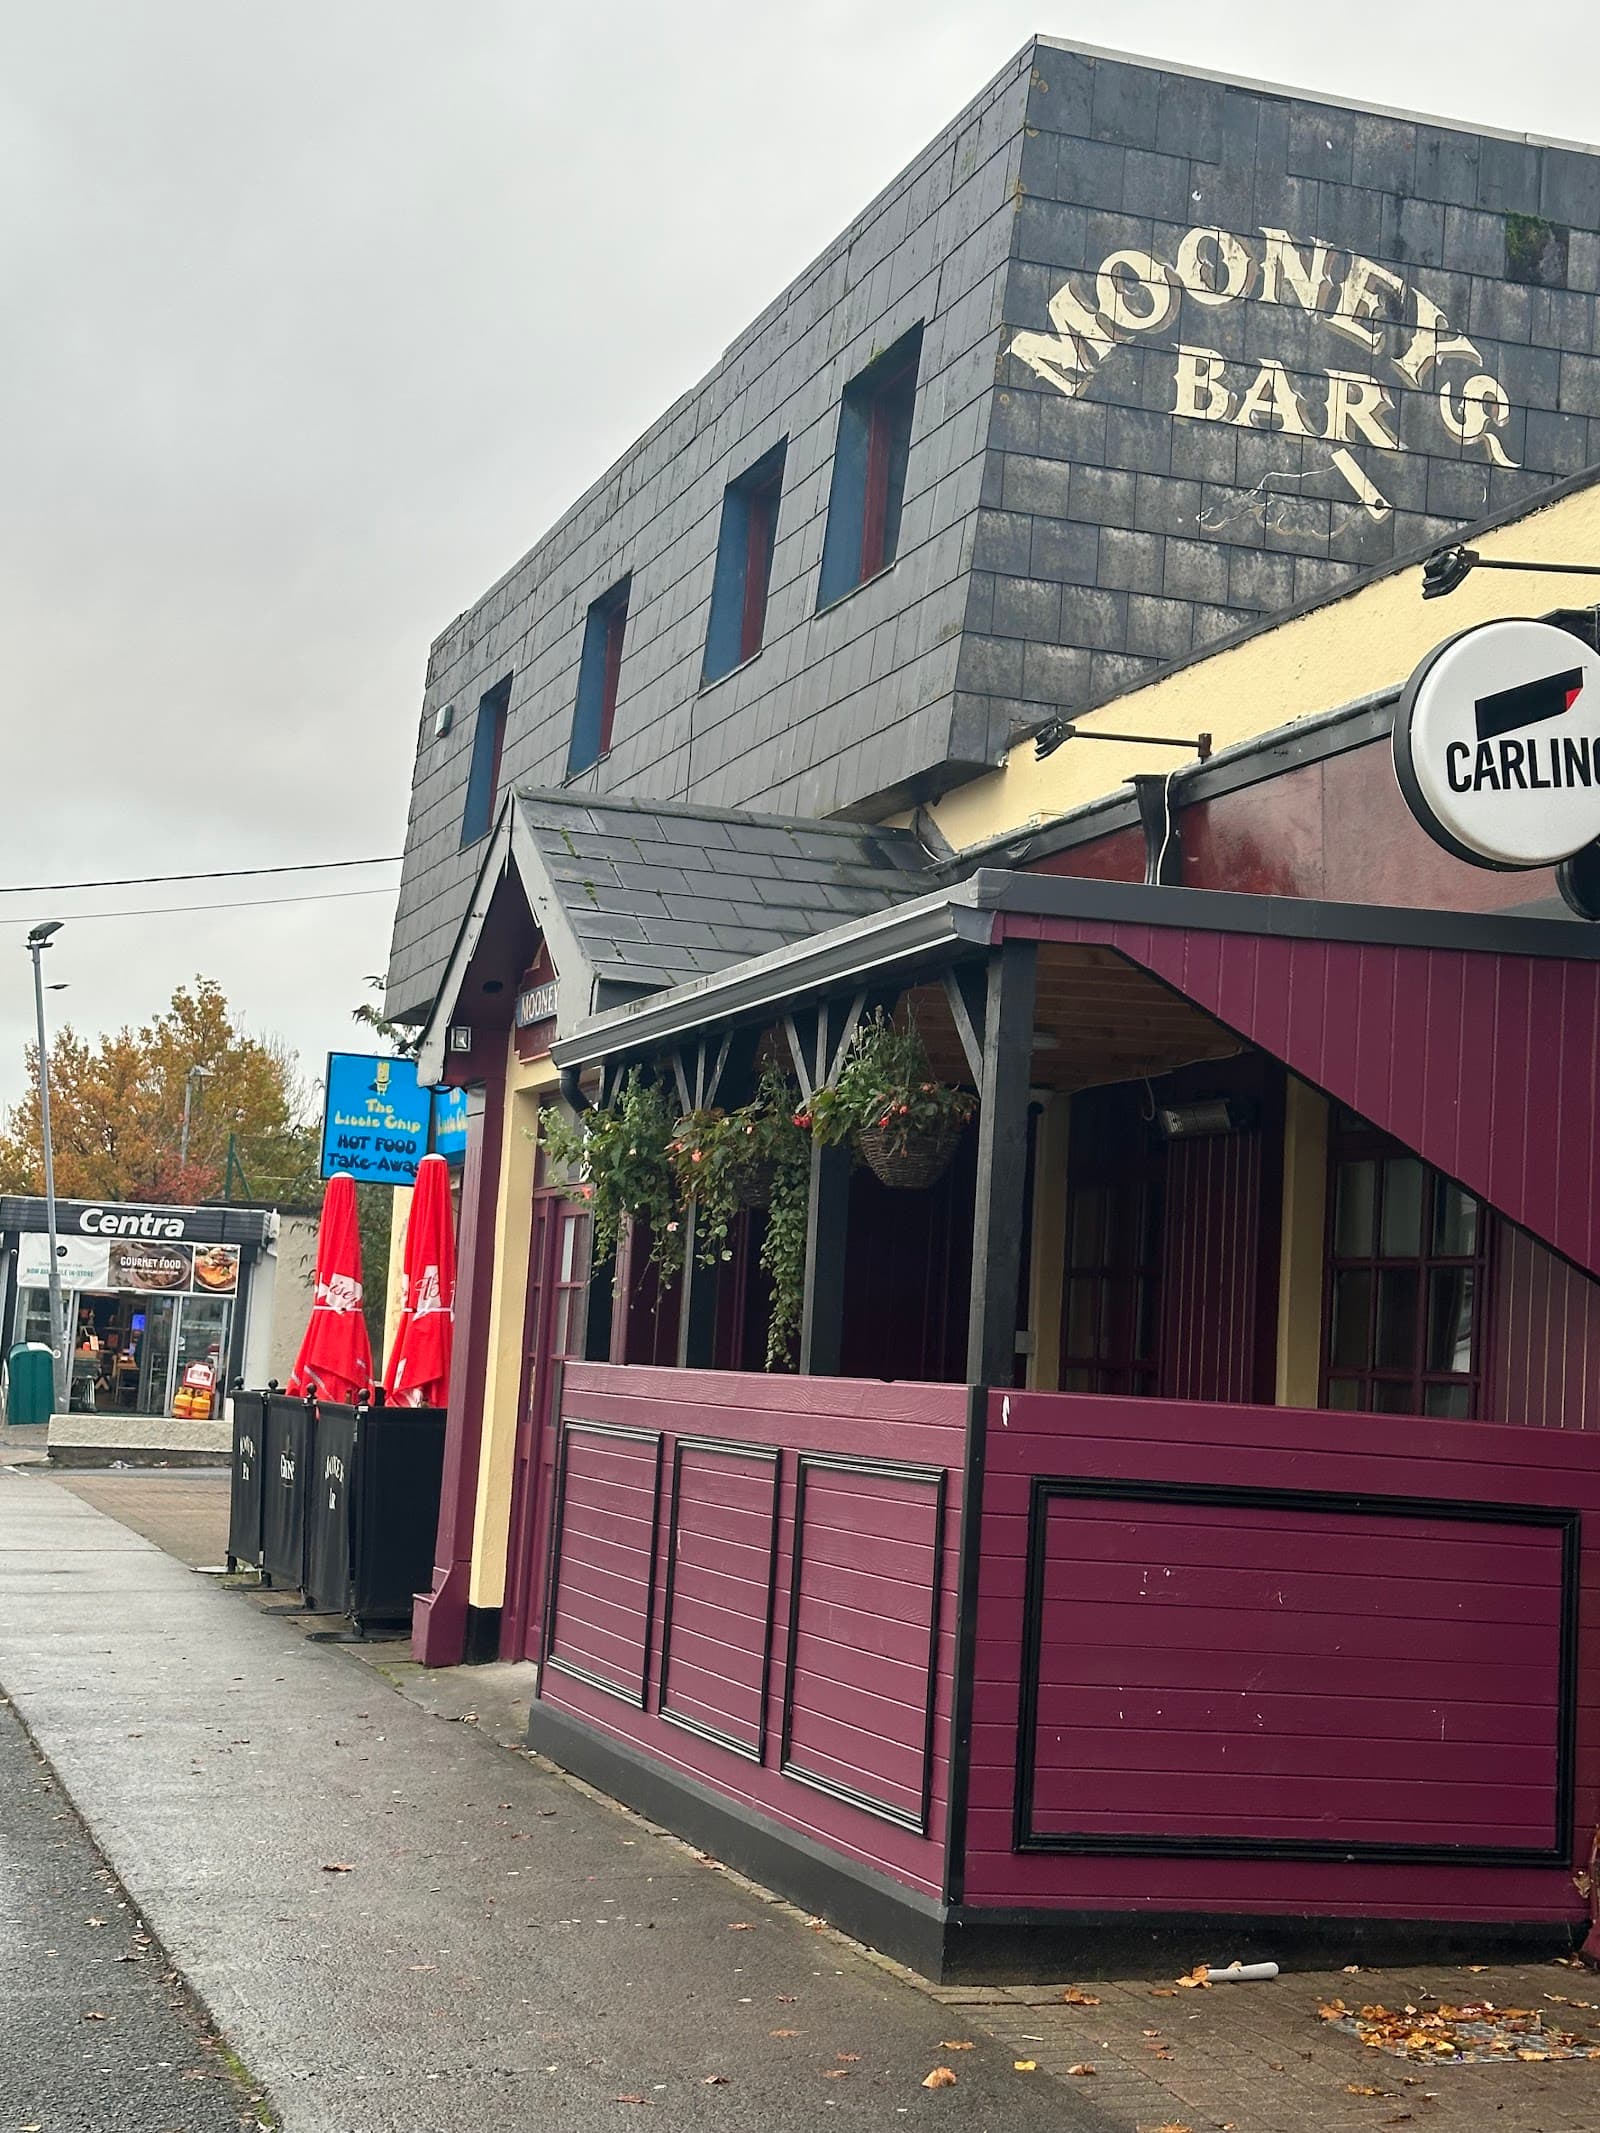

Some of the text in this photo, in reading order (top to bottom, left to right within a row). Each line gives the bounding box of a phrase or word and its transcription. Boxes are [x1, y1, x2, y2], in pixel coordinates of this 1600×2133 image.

[1168, 343, 1407, 451] BAR
[365, 1098, 394, 1114] The
[334, 1110, 381, 1128] Little
[384, 1115, 421, 1133] Chip
[337, 1134, 417, 1154] HOT FOOD
[79, 1208, 185, 1237] Centra
[120, 1256, 181, 1269] GOURMET FOOD
